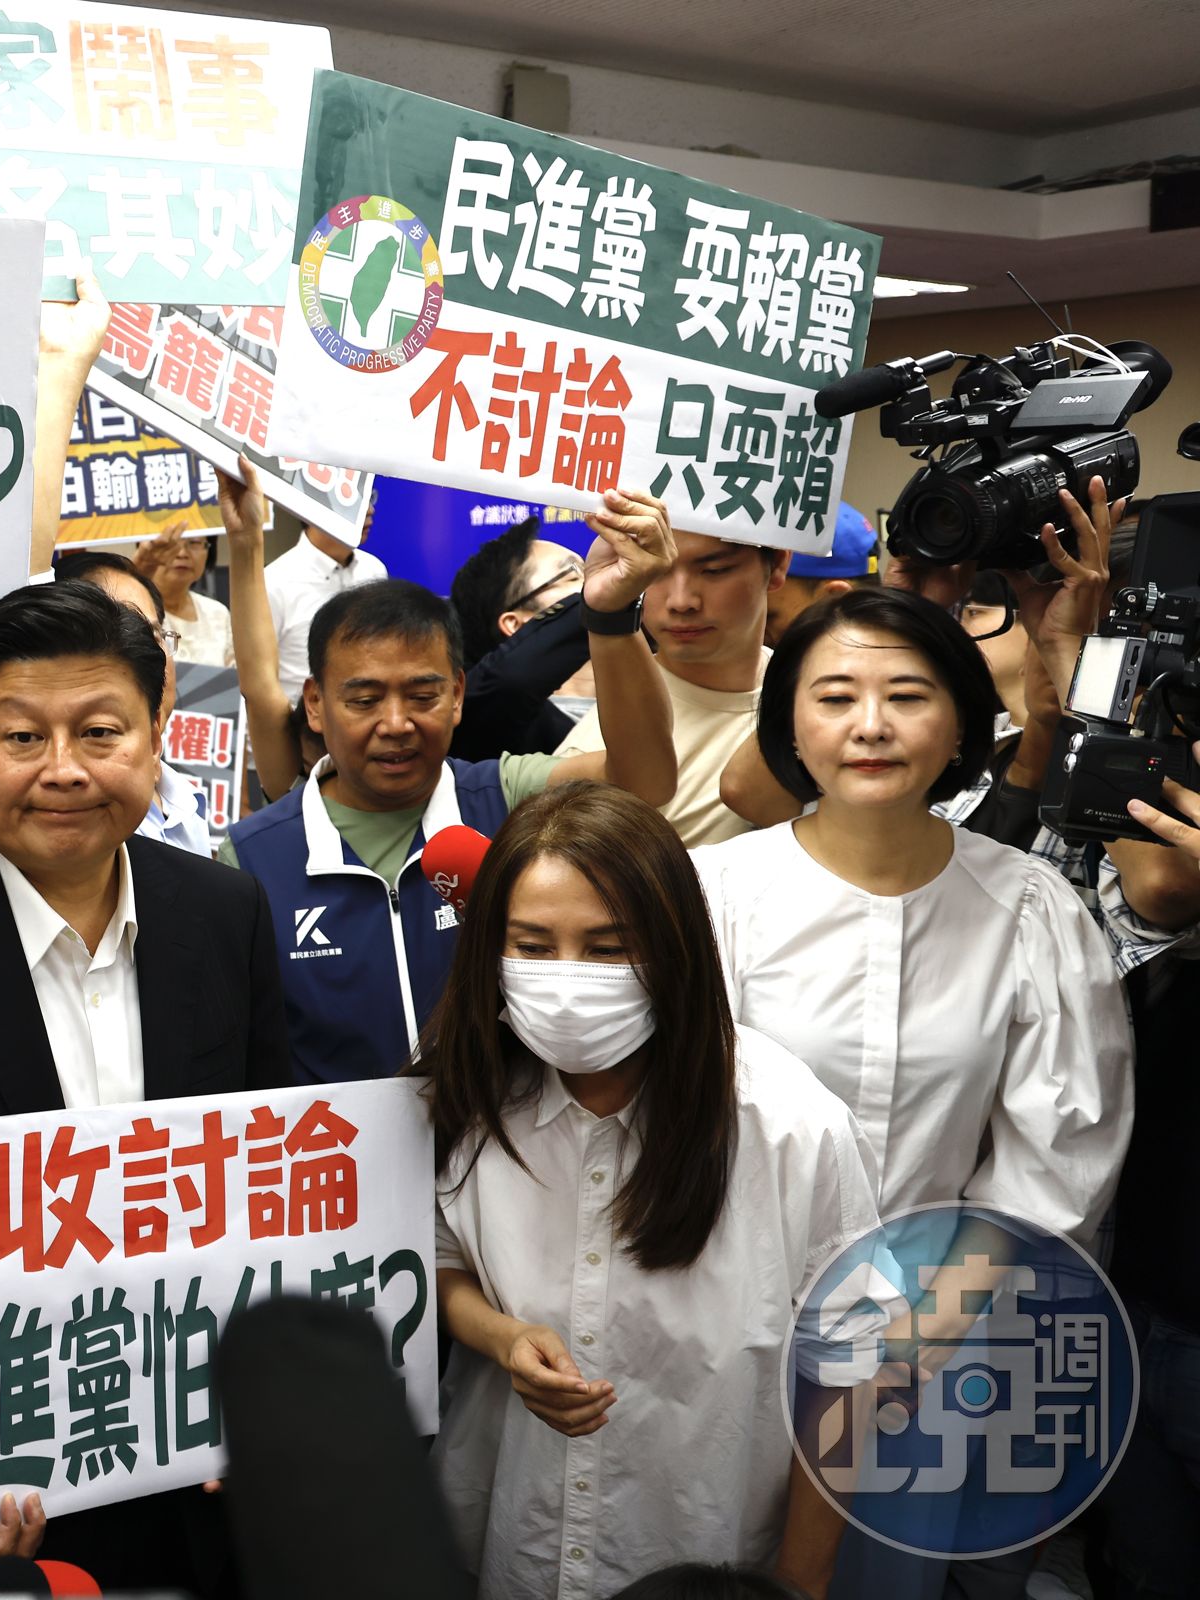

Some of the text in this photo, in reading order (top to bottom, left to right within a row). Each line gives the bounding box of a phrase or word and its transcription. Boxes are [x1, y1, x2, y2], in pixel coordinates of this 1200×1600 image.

[302, 262, 341, 354] DEMOCRATIC
[340, 334, 422, 370] PROGRESSIVE
[418, 290, 440, 339] PARTY
[440, 136, 864, 377] 民進黨 耍賴黨
[409, 328, 843, 537] 不討論 只耍賴
[167, 713, 230, 764] 權!
